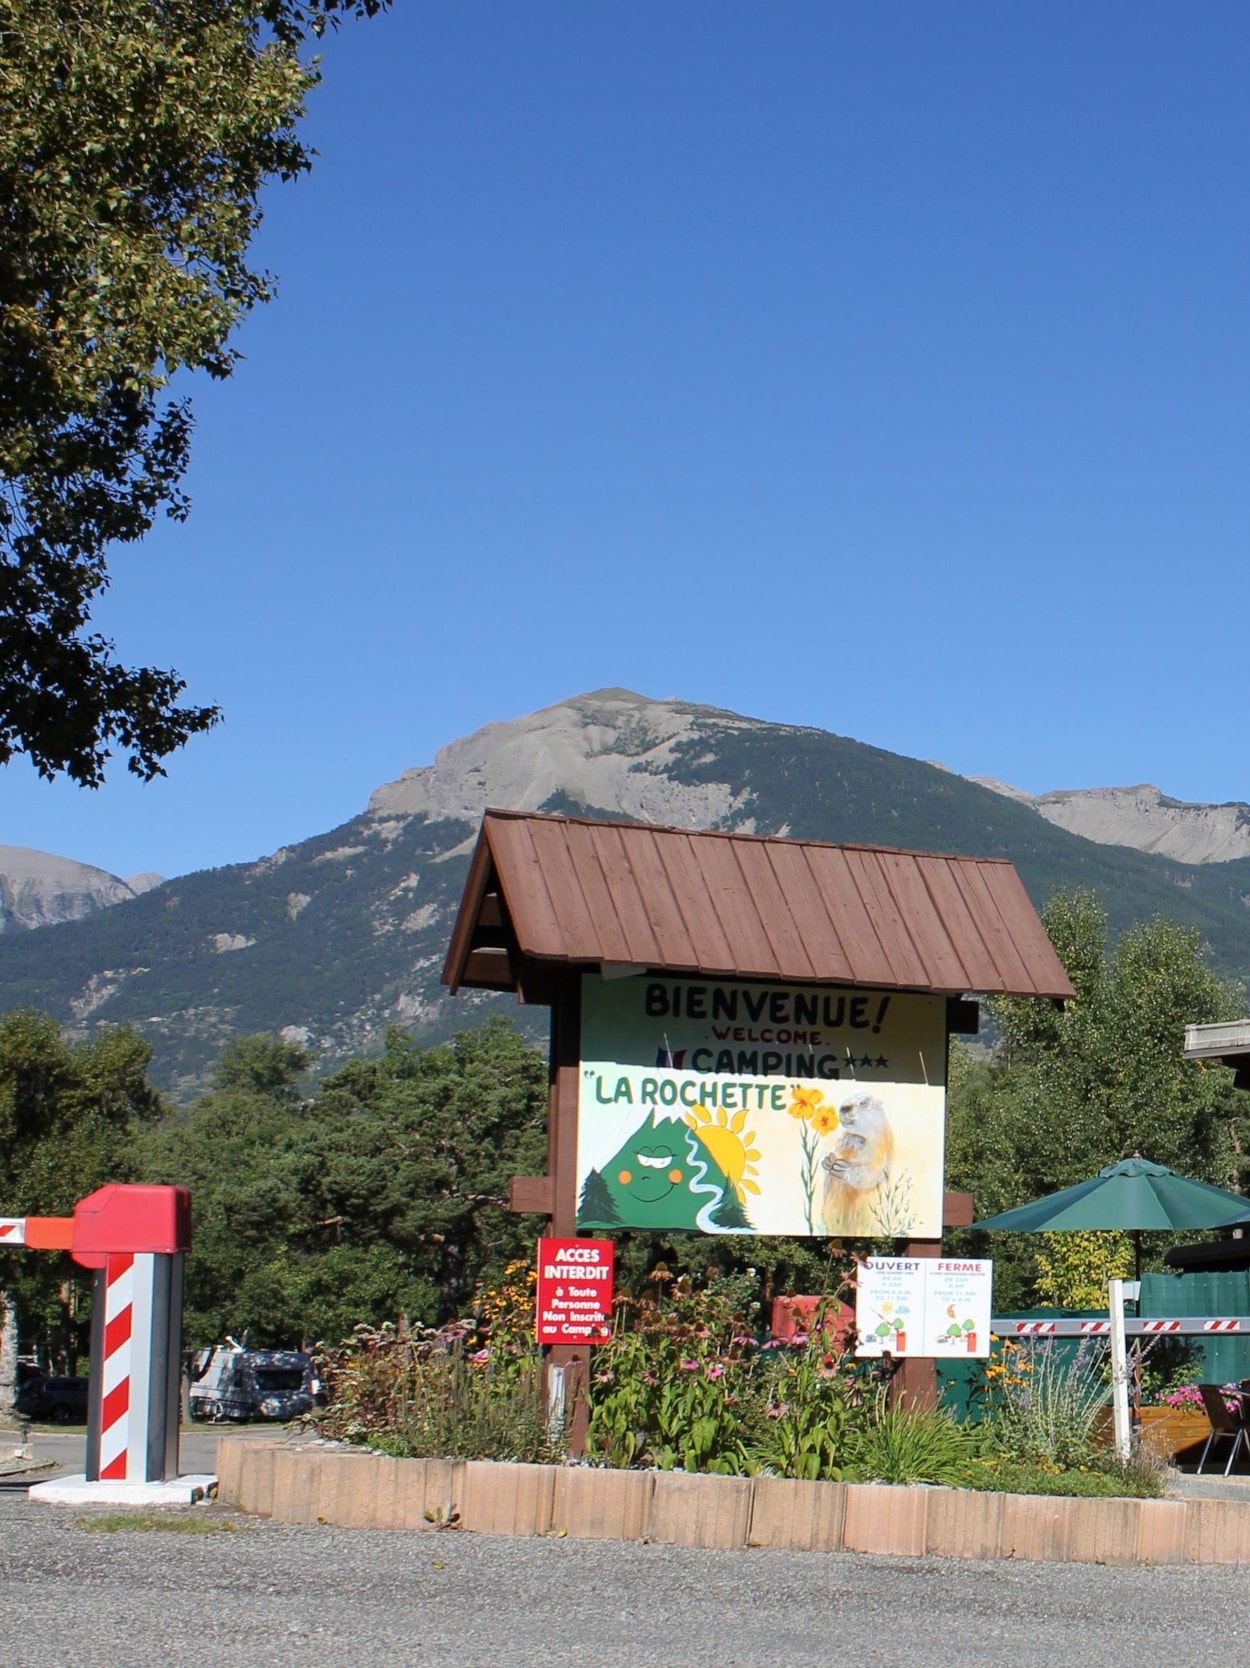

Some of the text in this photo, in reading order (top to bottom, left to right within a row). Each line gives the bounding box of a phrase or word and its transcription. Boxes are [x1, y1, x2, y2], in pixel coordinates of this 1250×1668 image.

[644, 983, 891, 1034] BIENVENUE!
[691, 1047, 840, 1080] CAMPING
[583, 1070, 633, 1105] "LA
[555, 1248, 600, 1263] ACCES
[544, 1265, 609, 1280] INTERDIT
[863, 1261, 921, 1271] OUVERT
[568, 1286, 597, 1297] Toute
[551, 1299, 601, 1310] Personne
[543, 1311, 566, 1321] Non
[542, 1325, 557, 1334] au
